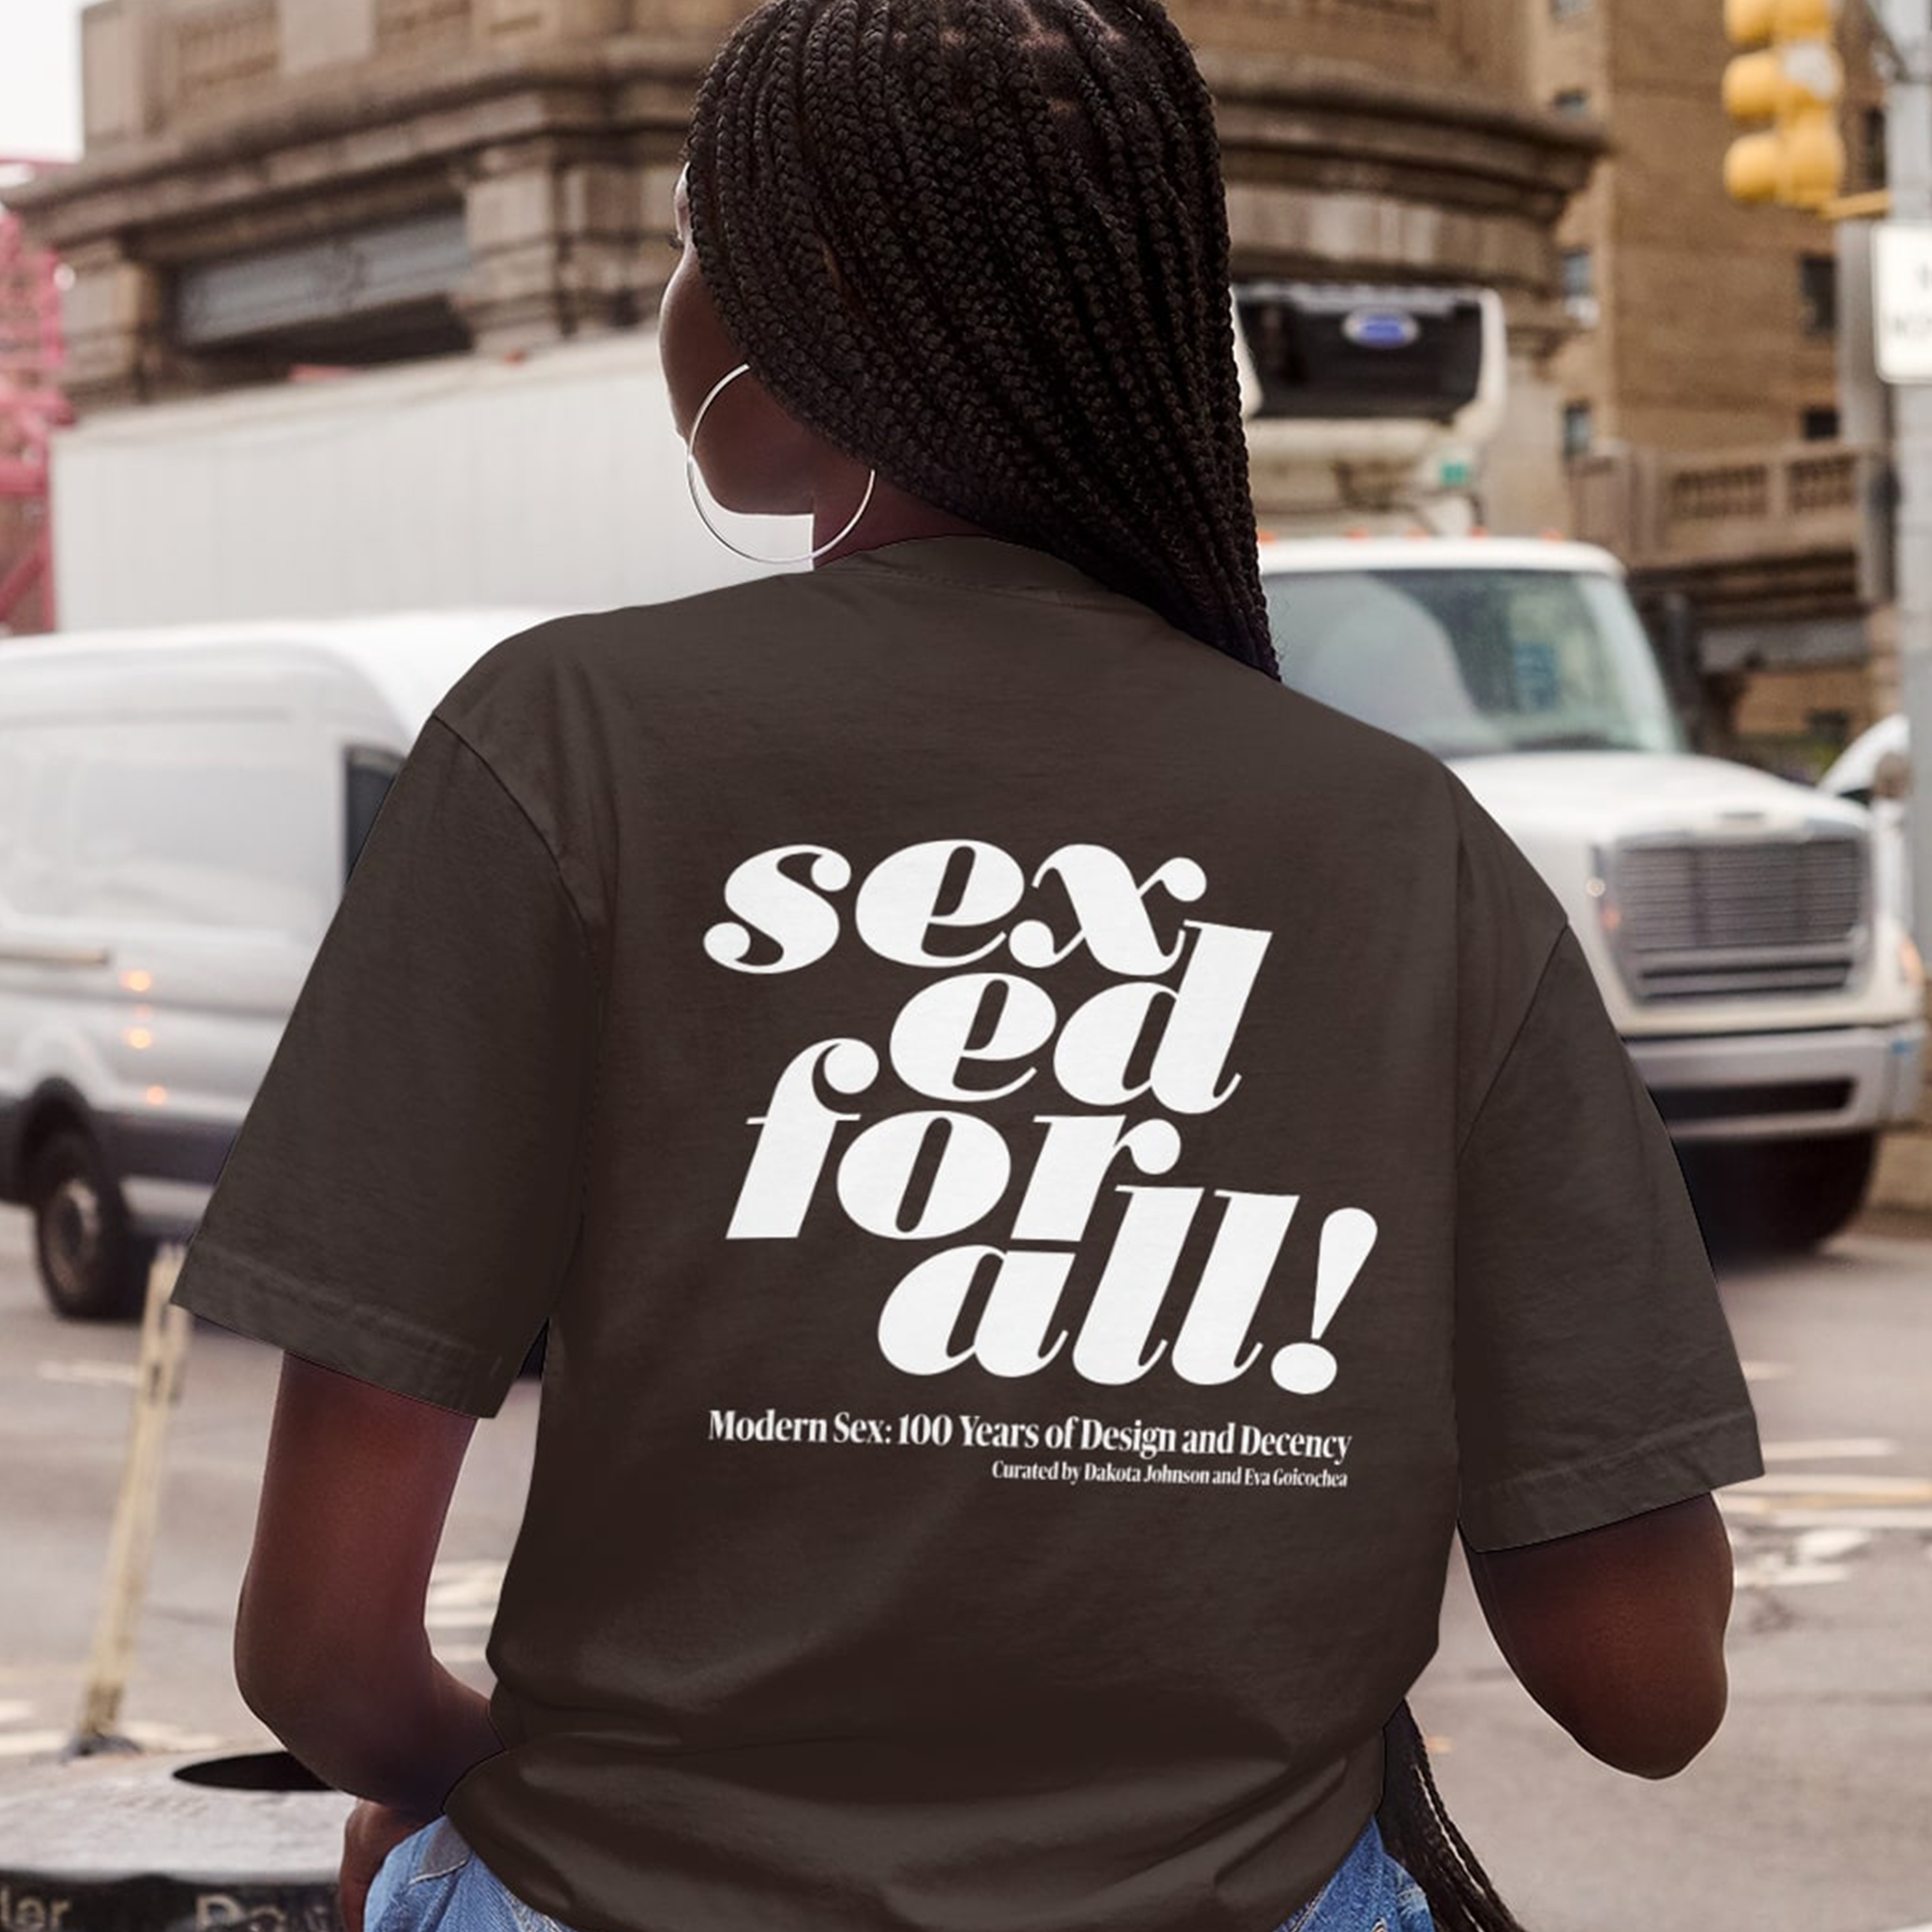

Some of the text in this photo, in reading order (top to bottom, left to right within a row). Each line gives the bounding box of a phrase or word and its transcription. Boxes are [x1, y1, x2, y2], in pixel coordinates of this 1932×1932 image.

[703, 838, 1208, 976] sex
[889, 919, 1273, 1115] ed
[725, 1037, 1181, 1242] for
[877, 1184, 1378, 1395] all!
[708, 1408, 1352, 1465] Modern Sex: 100 Years of Design and Decency
[991, 1461, 1349, 1488] Curated by Dakota Johnson and Eva Goicochea
